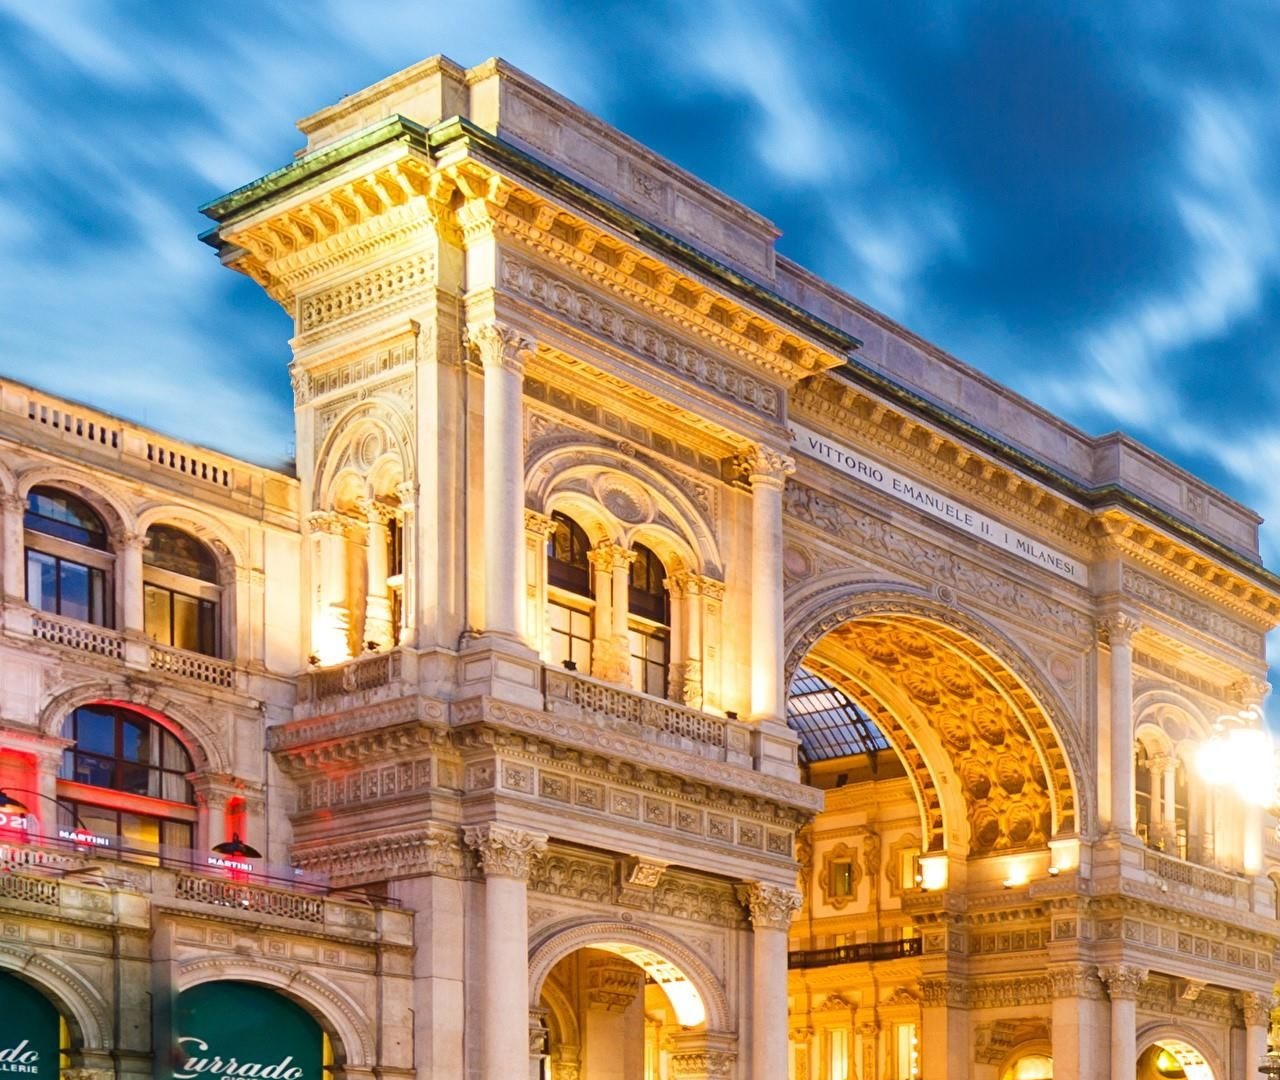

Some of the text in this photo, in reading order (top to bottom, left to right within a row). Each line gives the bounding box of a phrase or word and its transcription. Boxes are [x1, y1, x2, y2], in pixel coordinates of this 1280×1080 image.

[808, 436, 883, 482] VITTORIO
[892, 478, 974, 527] EMANUELE
[1016, 539, 1075, 576] MILANESI
[59, 829, 109, 846] MARTINI
[207, 856, 253, 872] MARTINI
[0, 1063, 38, 1074] LERIE
